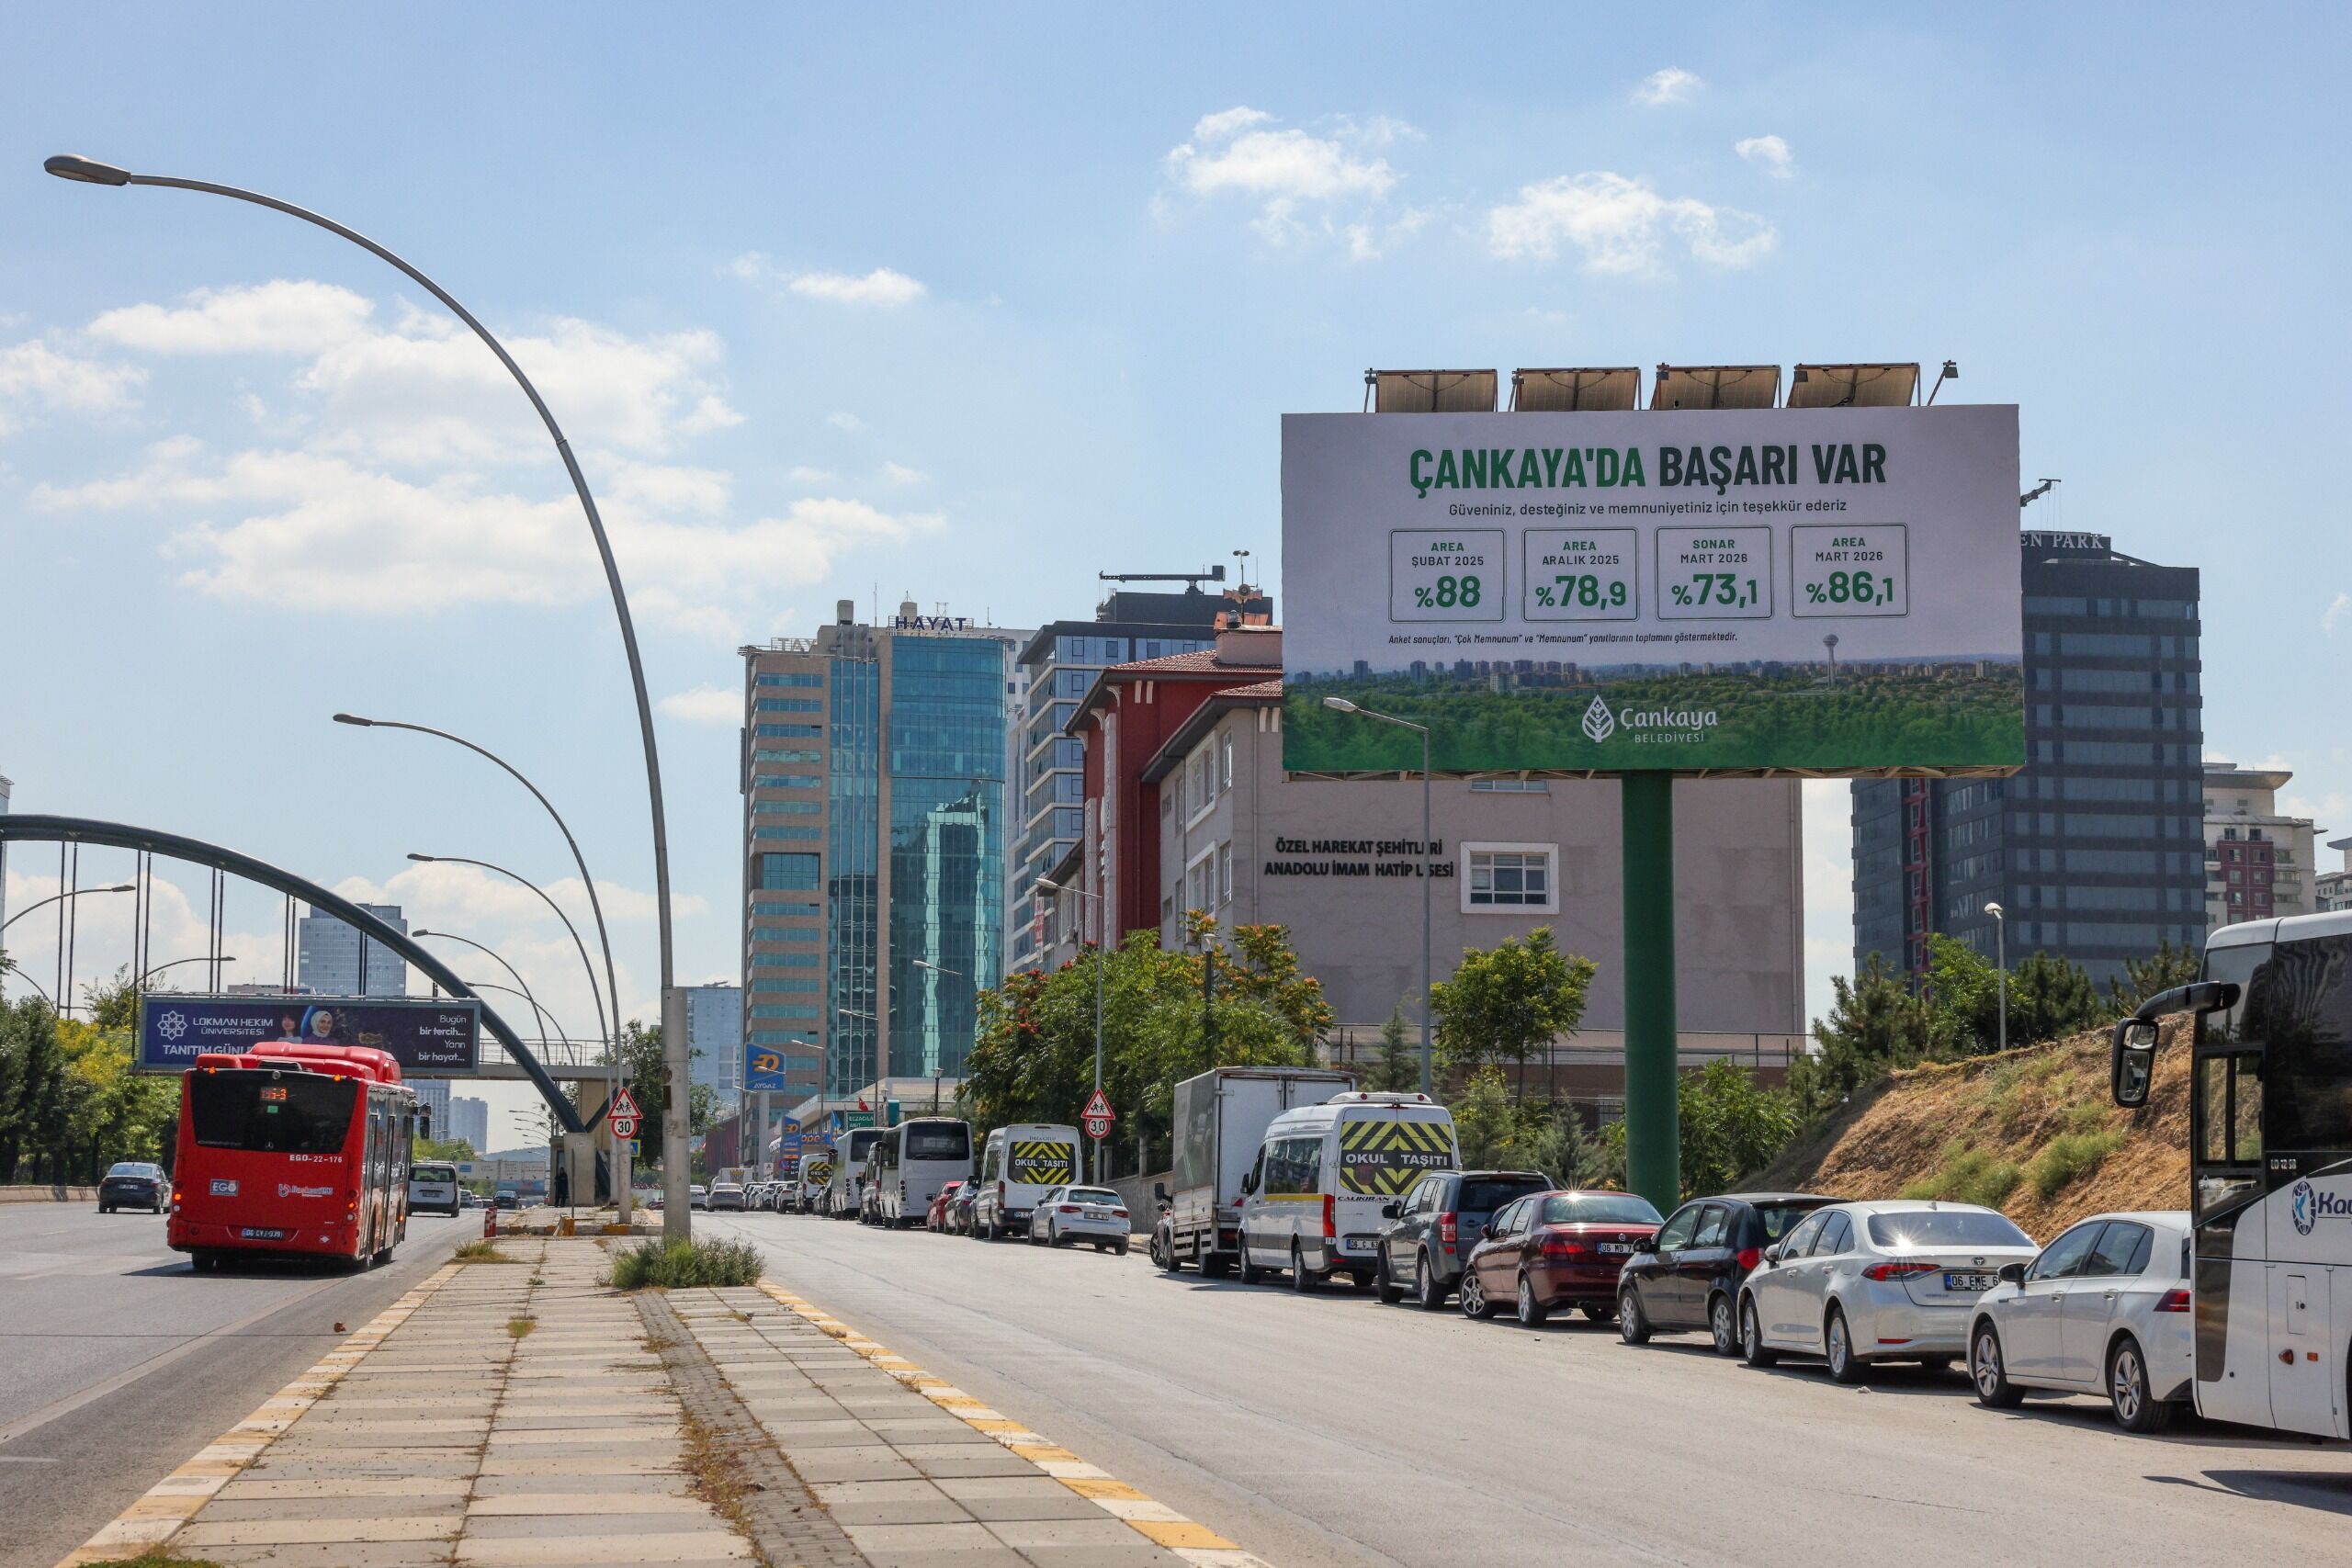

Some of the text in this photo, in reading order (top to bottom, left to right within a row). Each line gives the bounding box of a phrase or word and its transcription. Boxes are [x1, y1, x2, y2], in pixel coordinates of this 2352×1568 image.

[1409, 444, 1887, 499] ÇANKAYA'DA BAŞARI VAR
[1449, 500, 1847, 518] Güveniniz, desteğiniz ve memnuniyetiniz için teşekkür ederiz
[1562, 541, 1597, 551] AREA
[1692, 539, 1736, 549] SONAR
[1831, 537, 1866, 547] AREA
[2052, 532, 2104, 549] PARK
[1430, 542, 1464, 552] AREA
[1411, 556, 1485, 568] ŞUBAT 2025
[1542, 555, 1620, 565] ARALIK 2025
[1680, 553, 1748, 564] MART 2026
[1815, 551, 1883, 562] MART 2026
[1414, 575, 1481, 608] %88
[1535, 574, 1627, 611] %78,9
[1671, 573, 1758, 608] %73,1
[1805, 570, 1894, 606] %86,1
[895, 615, 967, 632] HAYAT
[1388, 635, 1411, 644] Anket
[1413, 635, 1452, 645] sonuçları,
[1589, 634, 1634, 644] yanıtlarının
[1635, 633, 1673, 644] toplamını
[1675, 632, 1738, 644] göstermektedir.
[1620, 705, 1718, 730] Çankaya
[1634, 730, 1705, 743] BELEDİYESİ
[1275, 837, 1443, 857] ÖZEL HAREKAT ŞEHİTLRİ
[1264, 860, 1454, 877] ANADOLU İMAM HATİP LSESİ
[192, 1017, 238, 1027] LOKMAN
[439, 1014, 467, 1025] Bugün
[419, 1026, 432, 1035] bir
[163, 1044, 210, 1055] TANITIM
[418, 1052, 431, 1061] bir
[617, 1121, 631, 1134] 30
[1091, 1121, 1106, 1132] 30
[1014, 1158, 1038, 1168] OKUL
[1345, 1153, 1448, 1168] OKUL TAŞITI
[1602, 1244, 1611, 1252] 06
[1951, 1275, 1963, 1286] 06
[1969, 1275, 1987, 1287] EME
